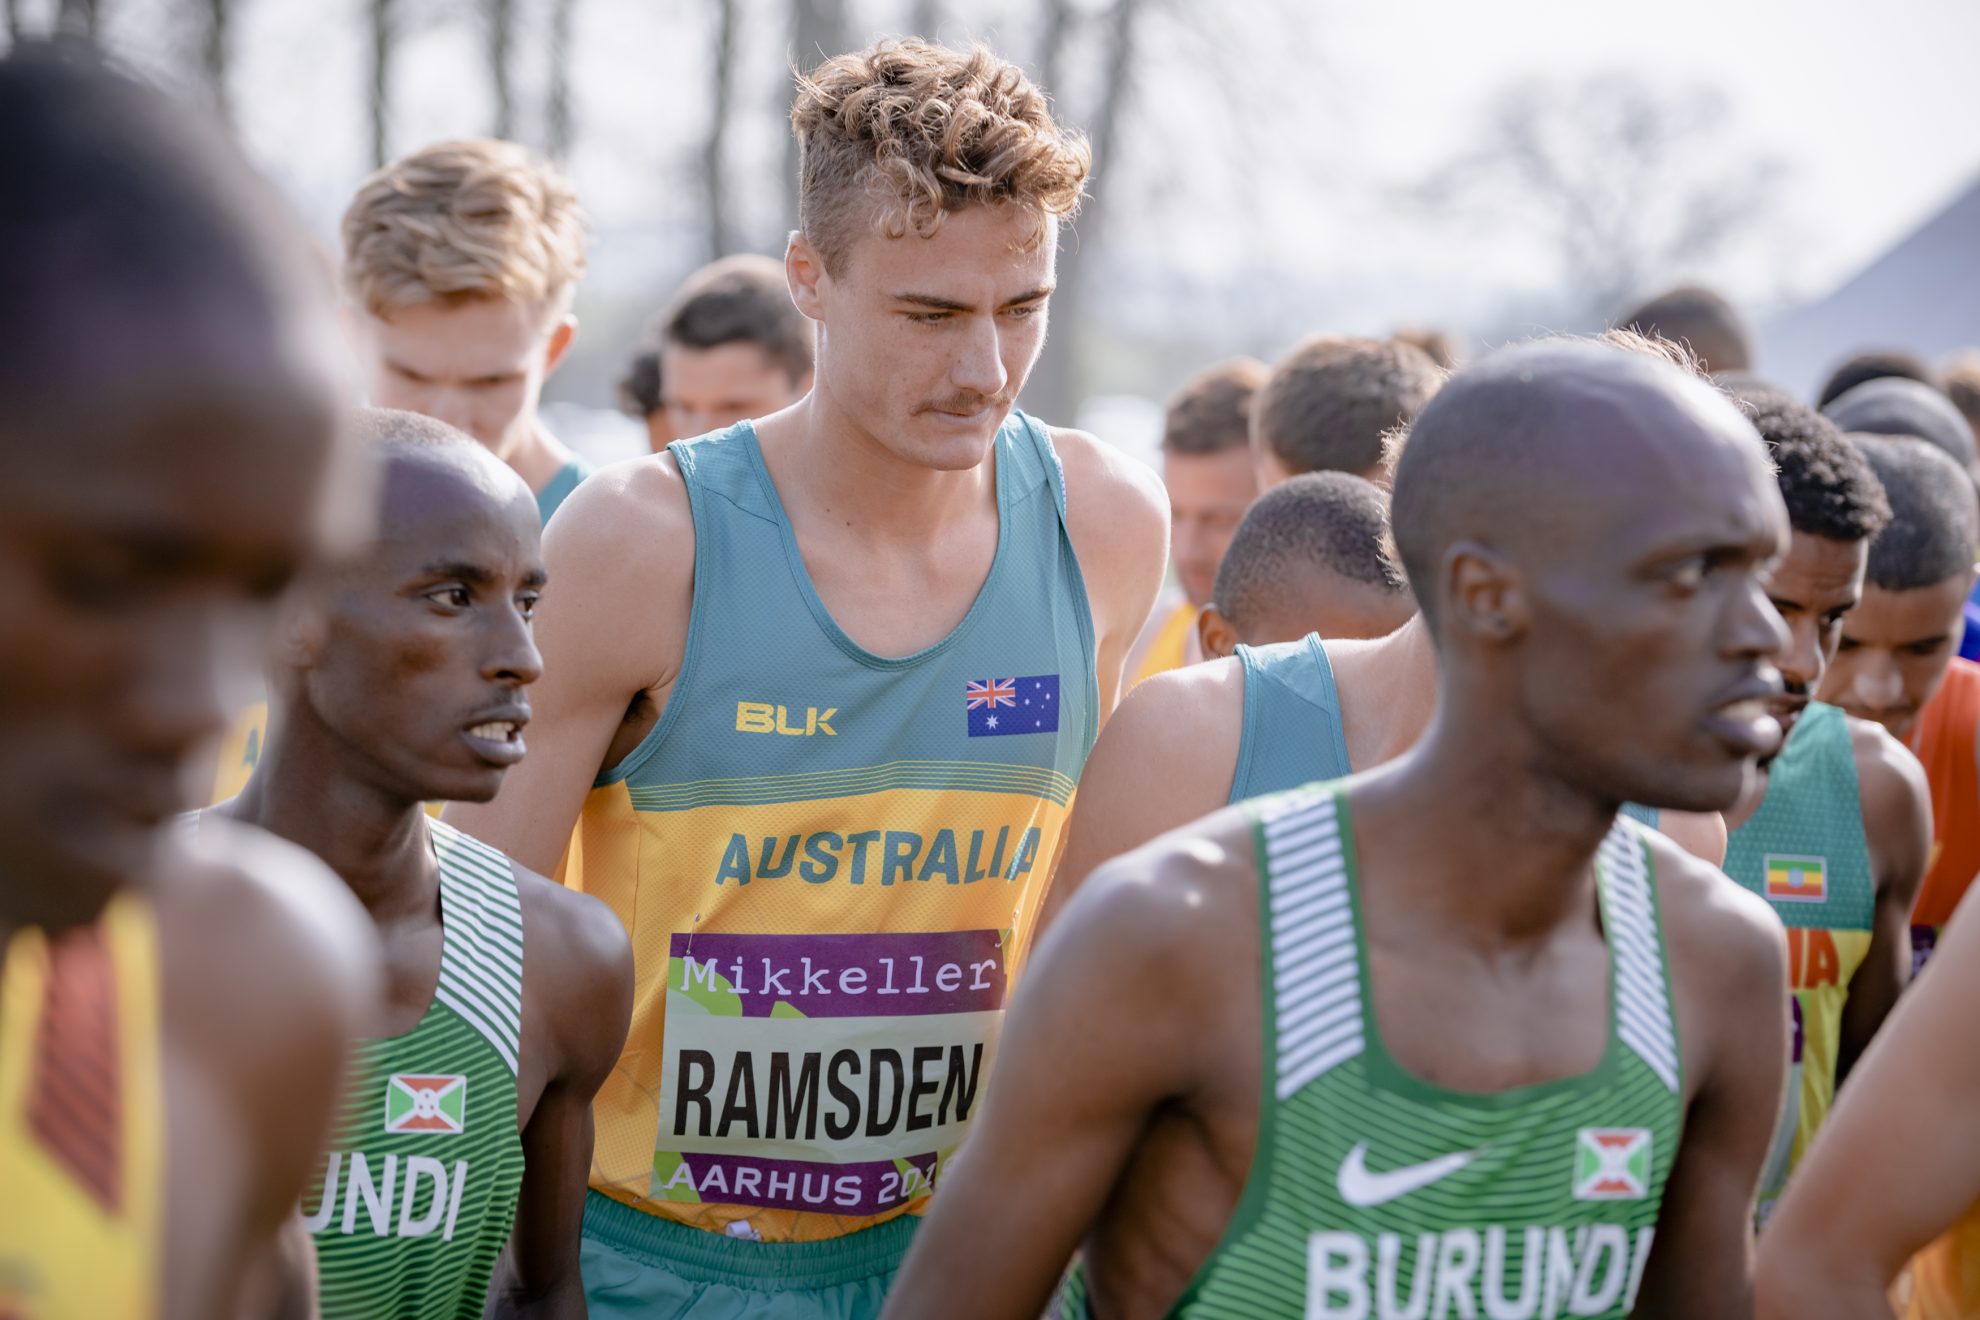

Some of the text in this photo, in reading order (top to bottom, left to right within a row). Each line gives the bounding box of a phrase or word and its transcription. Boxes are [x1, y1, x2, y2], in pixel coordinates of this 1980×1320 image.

[736, 701, 838, 736] BLK
[715, 825, 1042, 886] AUSTRALIA
[680, 955, 997, 996] Mikkeller
[673, 1043, 983, 1141] RAMSDEN
[663, 1162, 863, 1207] AARHUS
[1304, 1223, 1655, 1320] BURUNDI
